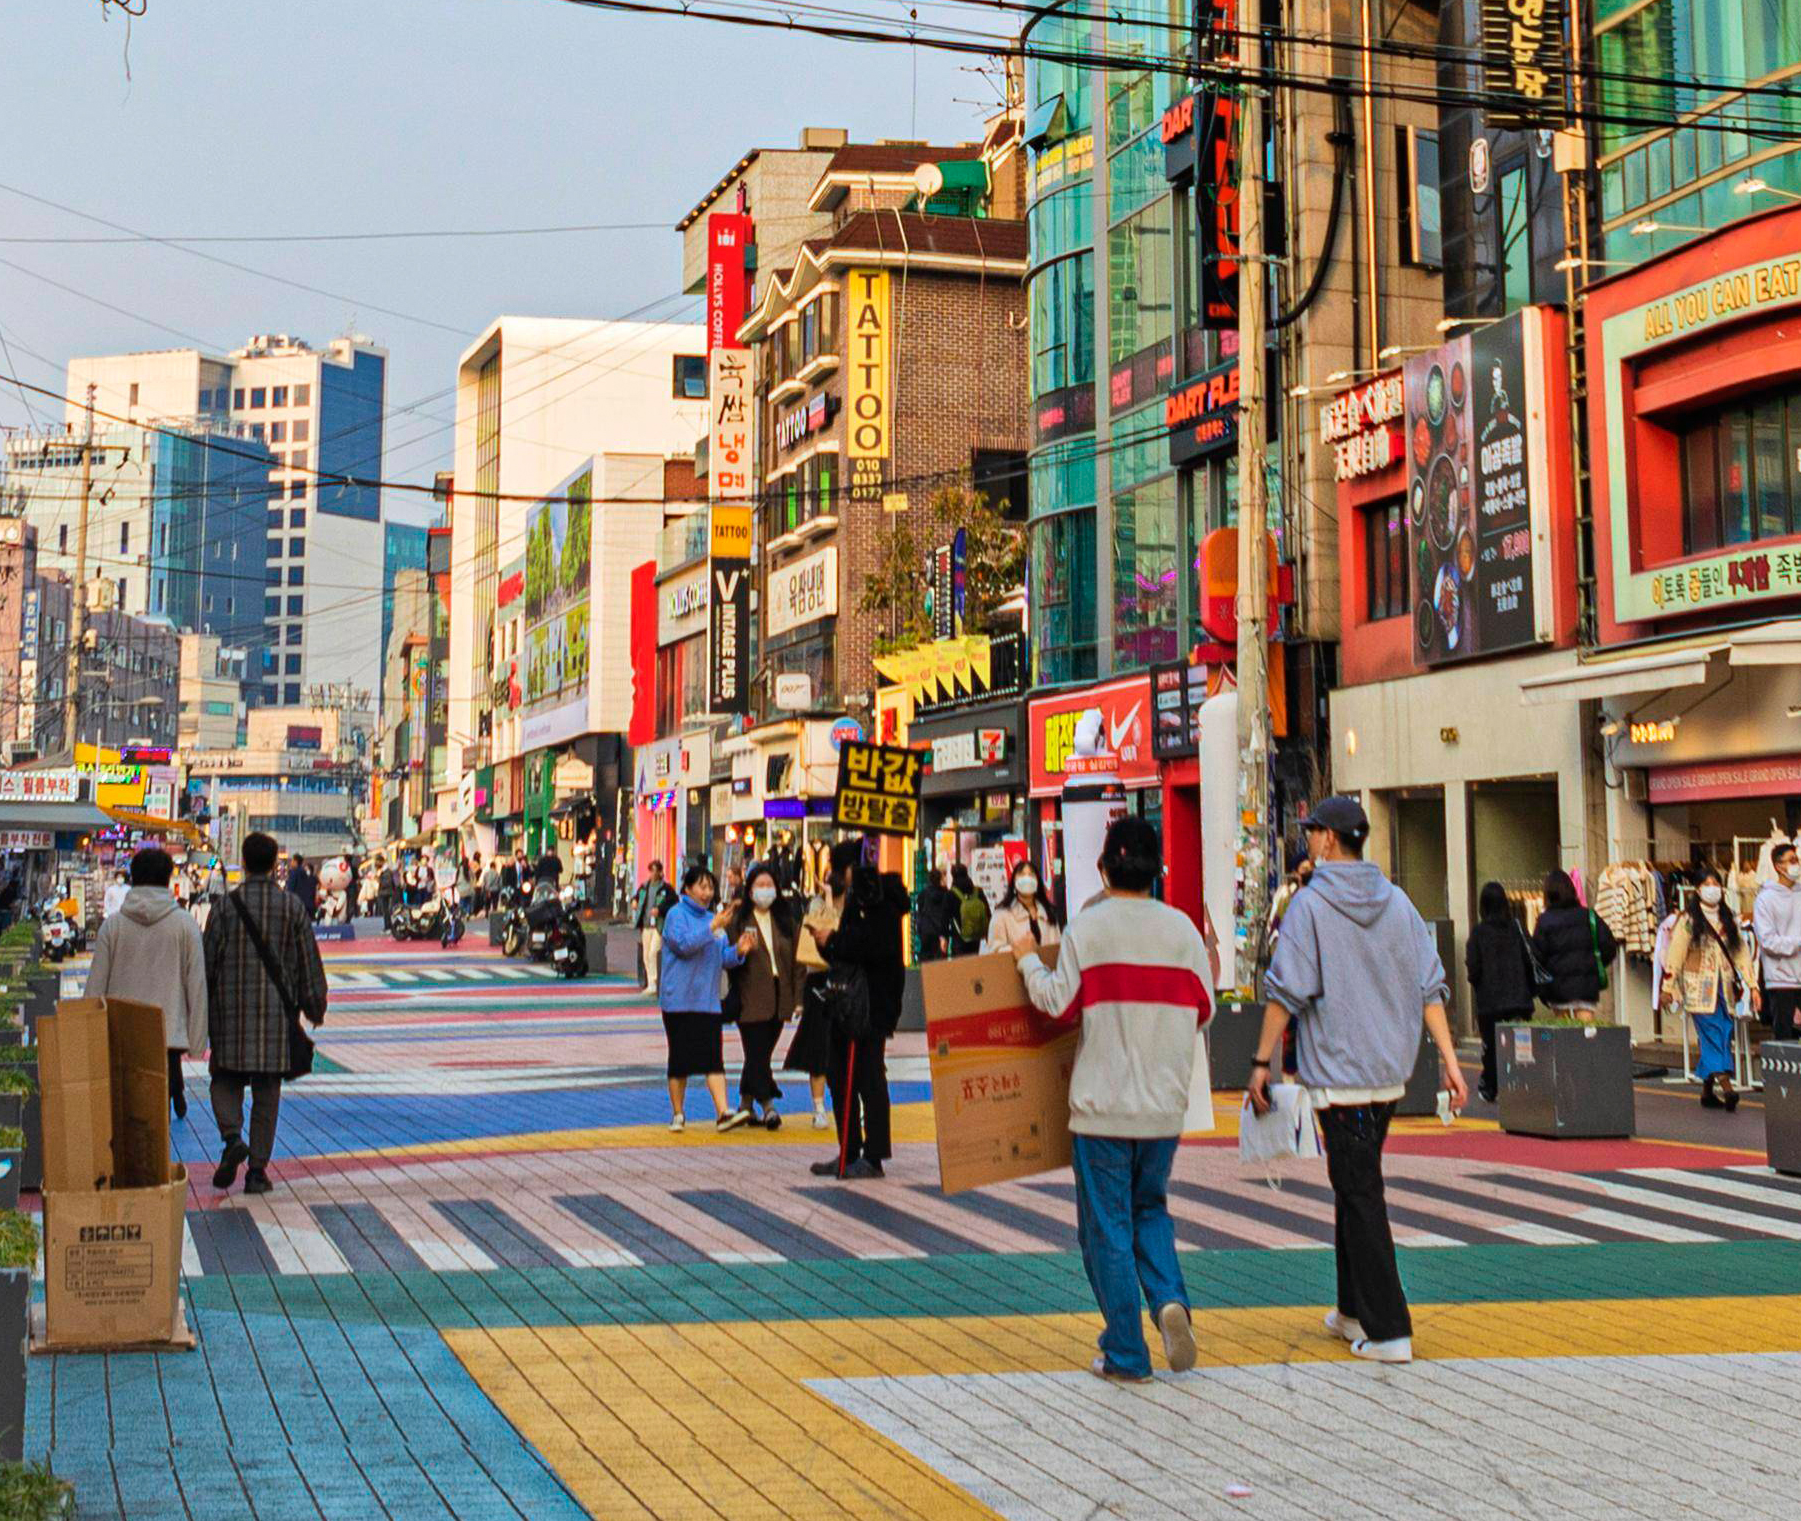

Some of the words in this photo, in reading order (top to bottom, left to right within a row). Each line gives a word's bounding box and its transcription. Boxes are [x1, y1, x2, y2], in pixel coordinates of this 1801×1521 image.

[712, 263, 723, 308] HOLLYS
[1643, 300, 1675, 342] ALL
[1675, 288, 1709, 327] YOU
[1712, 276, 1751, 315] CAN
[1756, 260, 1801, 302] EAT
[854, 273, 883, 451] TATTOO
[1165, 378, 1207, 428] DART
[1208, 368, 1240, 414] FLE
[718, 355, 746, 503] 육쌈냉면
[776, 406, 807, 453] TATTOO
[856, 460, 880, 472] 010
[714, 525, 748, 540] TATTOO
[721, 658, 736, 699] PLUS
[23, 776, 70, 795] 필름부착
[848, 746, 918, 796] 반값
[842, 794, 916, 829] 방탈출
